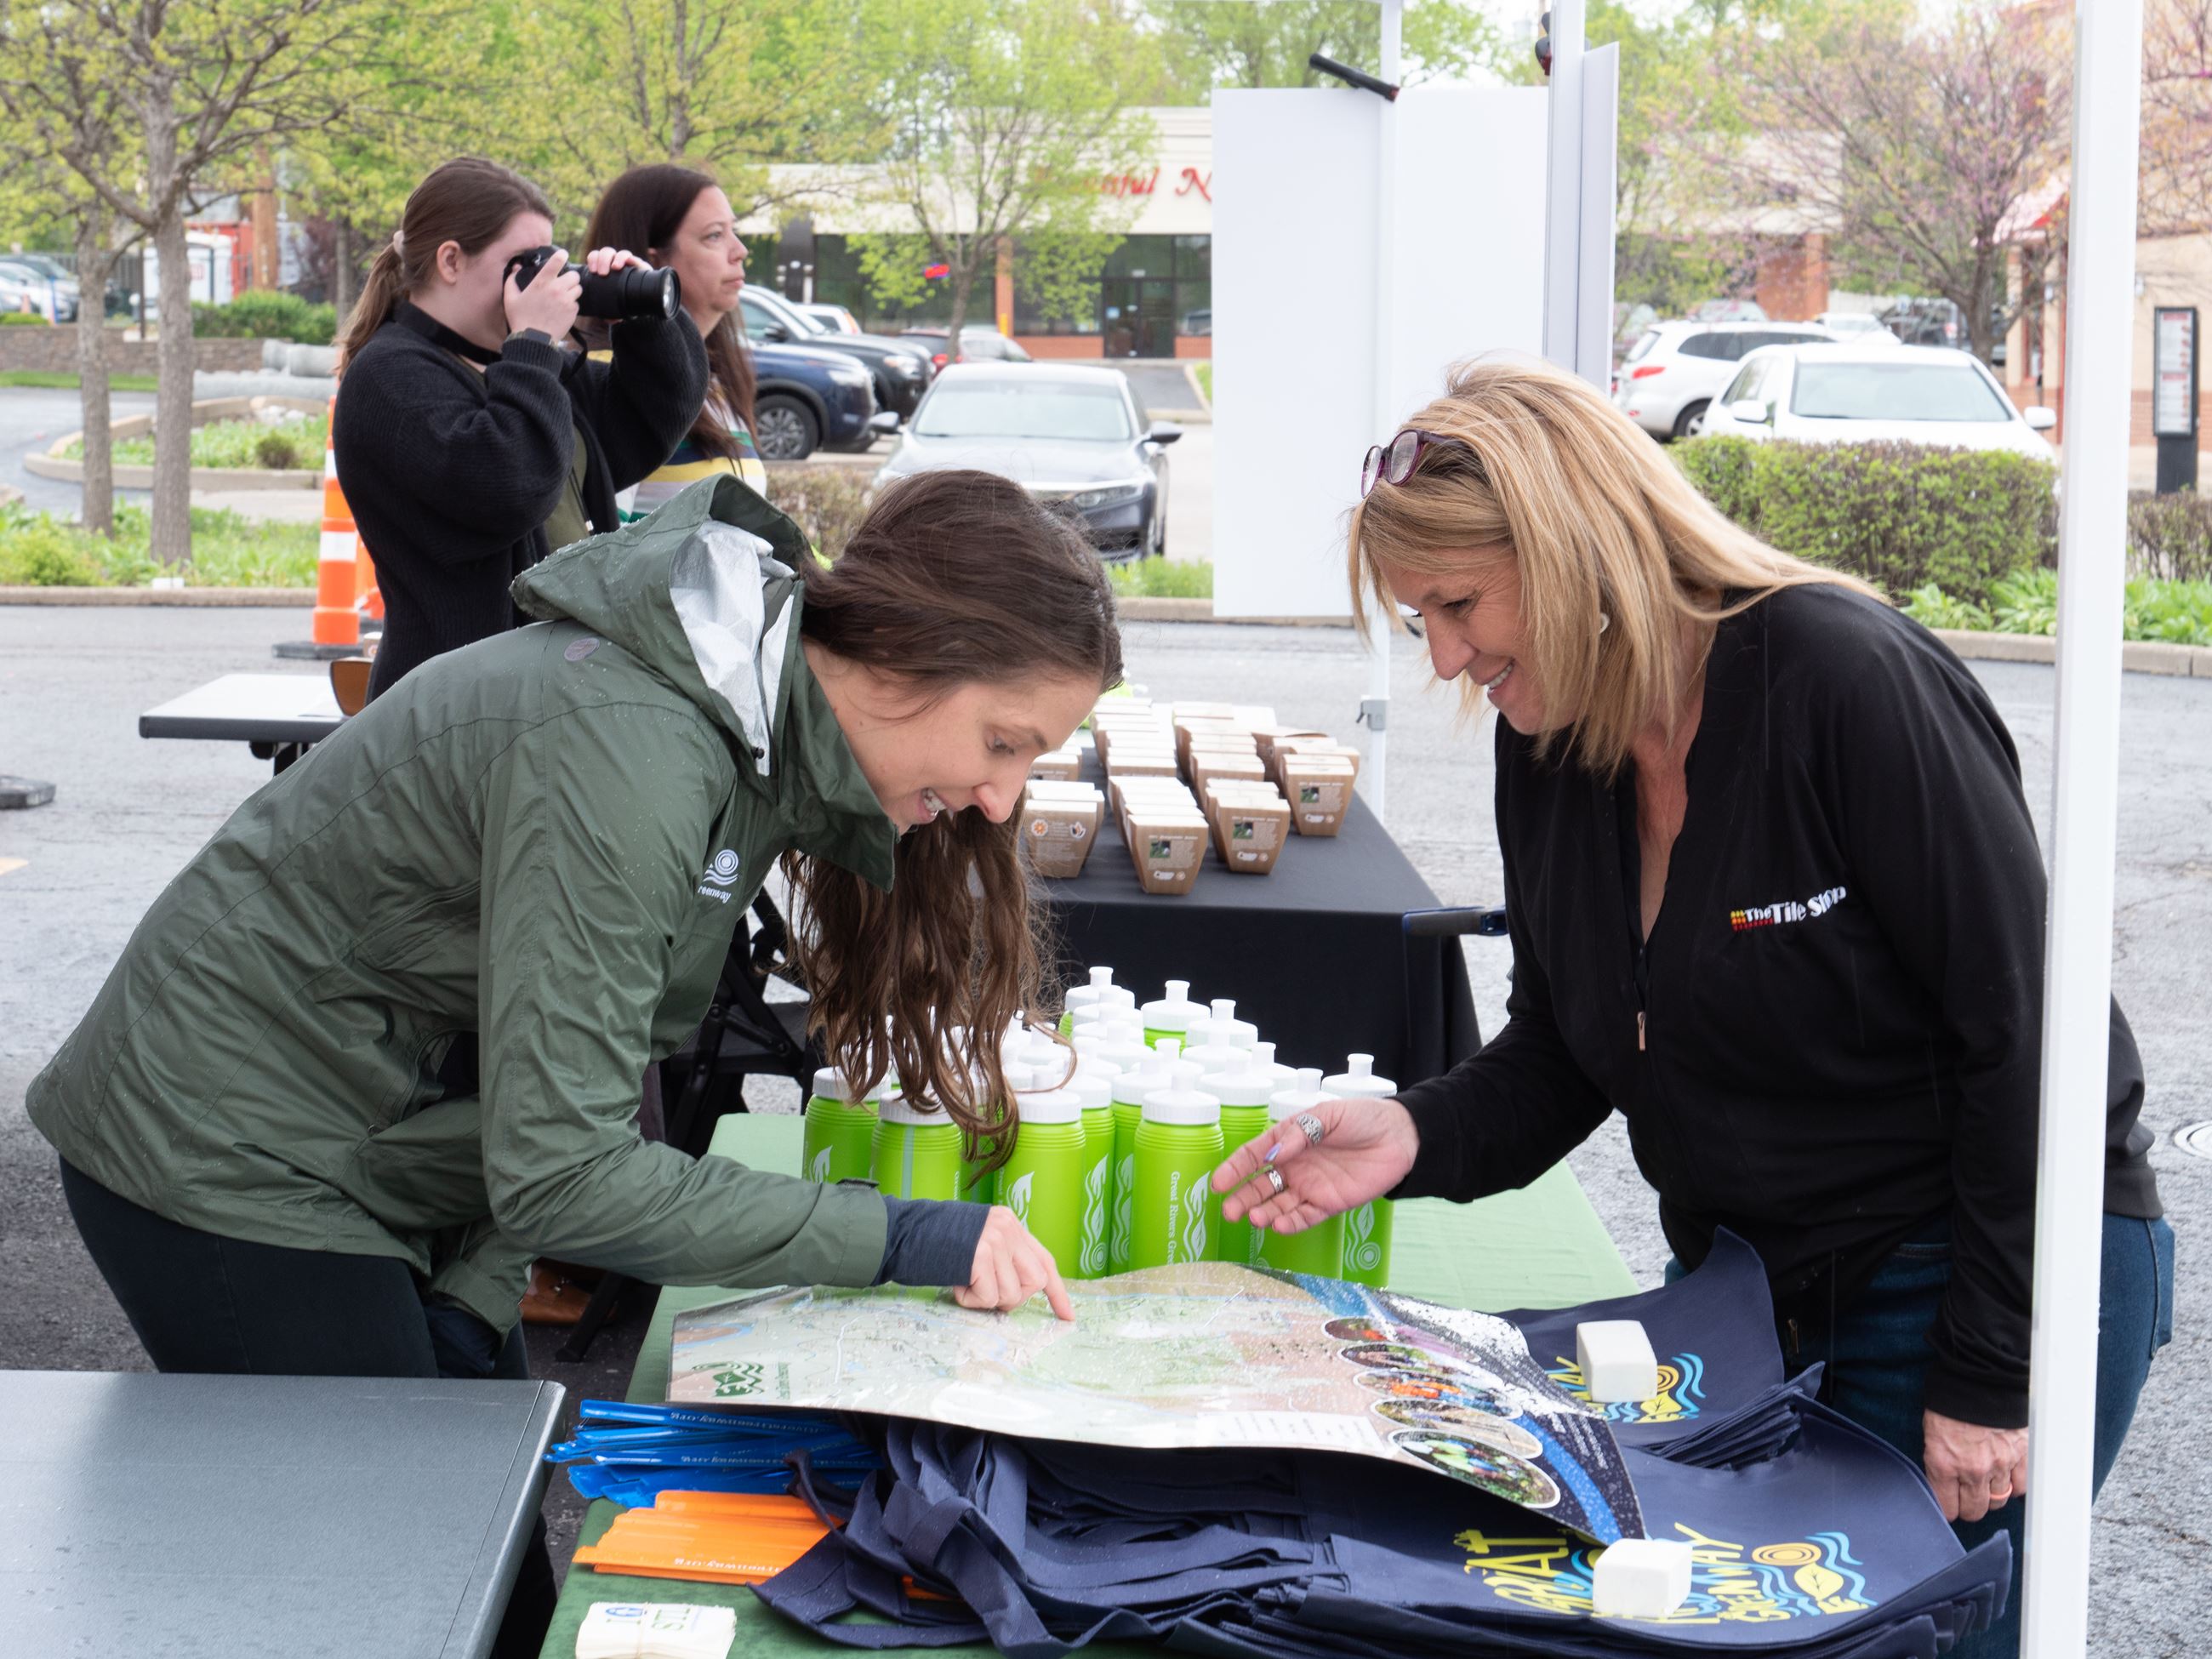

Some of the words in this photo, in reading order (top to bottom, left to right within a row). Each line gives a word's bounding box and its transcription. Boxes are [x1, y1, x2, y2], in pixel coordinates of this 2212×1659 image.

[1744, 907, 1772, 922] The
[1770, 901, 1807, 925] Tile
[1171, 1171, 1180, 1200] Great
[1169, 1204, 1179, 1238] Rivers
